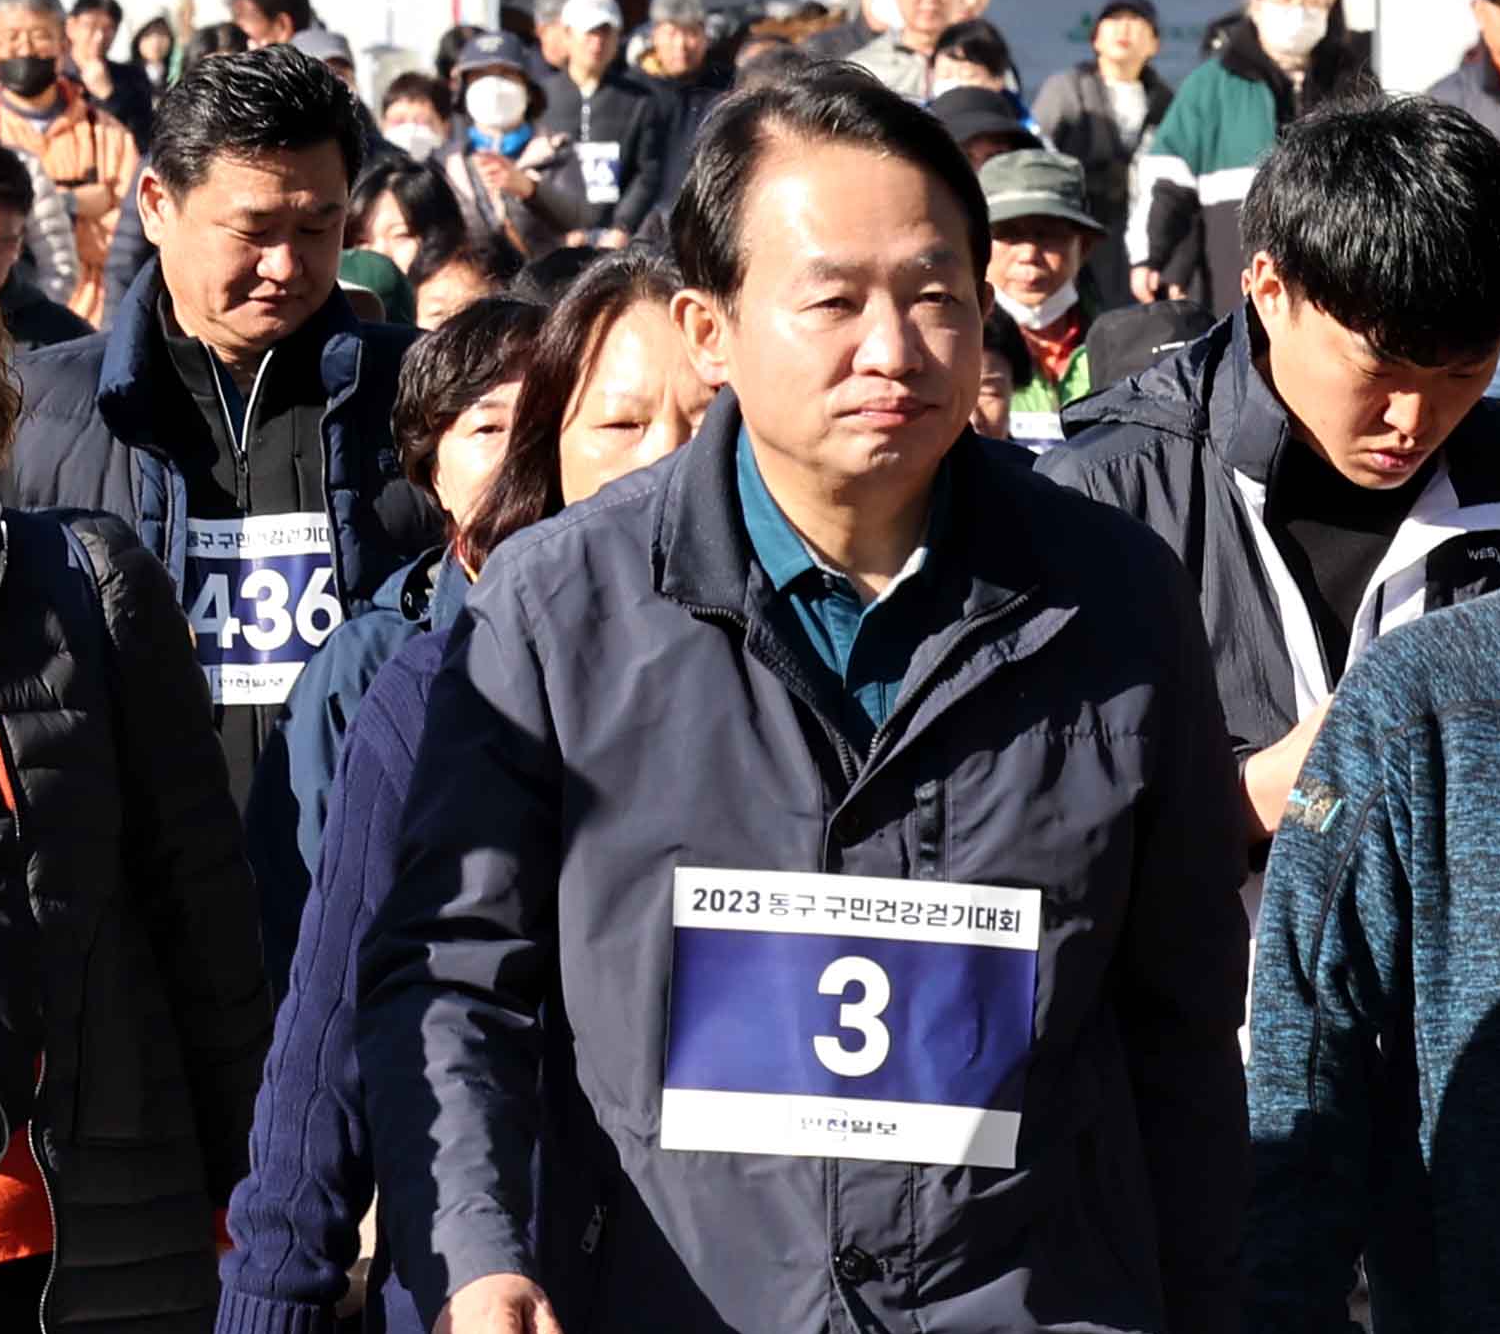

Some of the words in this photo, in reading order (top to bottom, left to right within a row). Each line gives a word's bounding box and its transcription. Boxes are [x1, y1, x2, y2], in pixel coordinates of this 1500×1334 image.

[189, 568, 342, 651] 436
[692, 889, 761, 914] 2023
[769, 893, 817, 917] 동구
[824, 897, 1021, 934] 구민건강걷기대회
[813, 955, 891, 1077] 3
